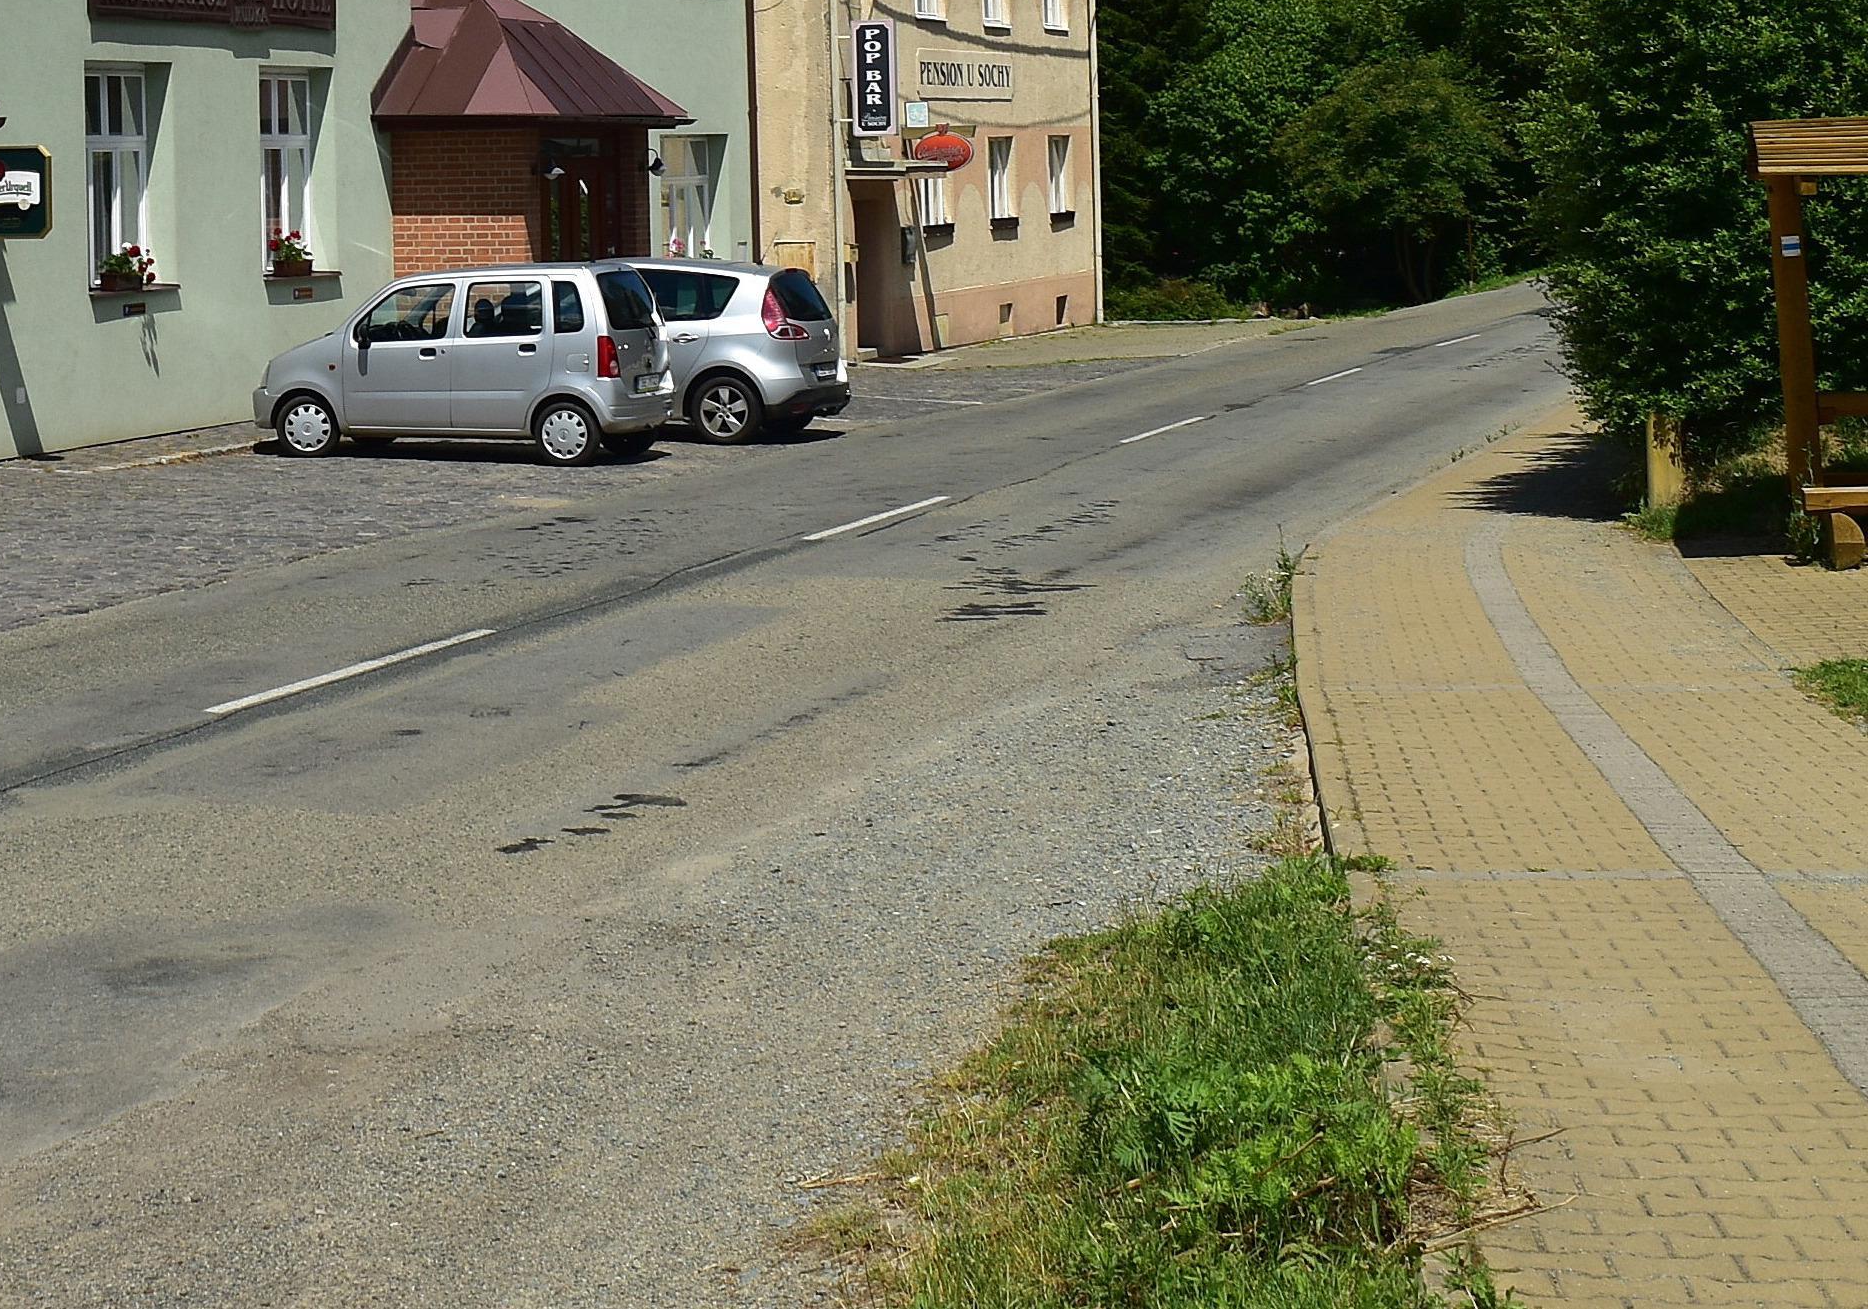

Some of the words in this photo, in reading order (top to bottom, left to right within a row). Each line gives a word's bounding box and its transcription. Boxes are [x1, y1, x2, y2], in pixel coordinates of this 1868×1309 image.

[864, 28, 882, 64] POP
[865, 70, 883, 105] BAR
[920, 61, 964, 86] PENSION
[967, 63, 974, 86] U
[978, 64, 1011, 87] SOCHY
[5, 178, 32, 197] Urquell
